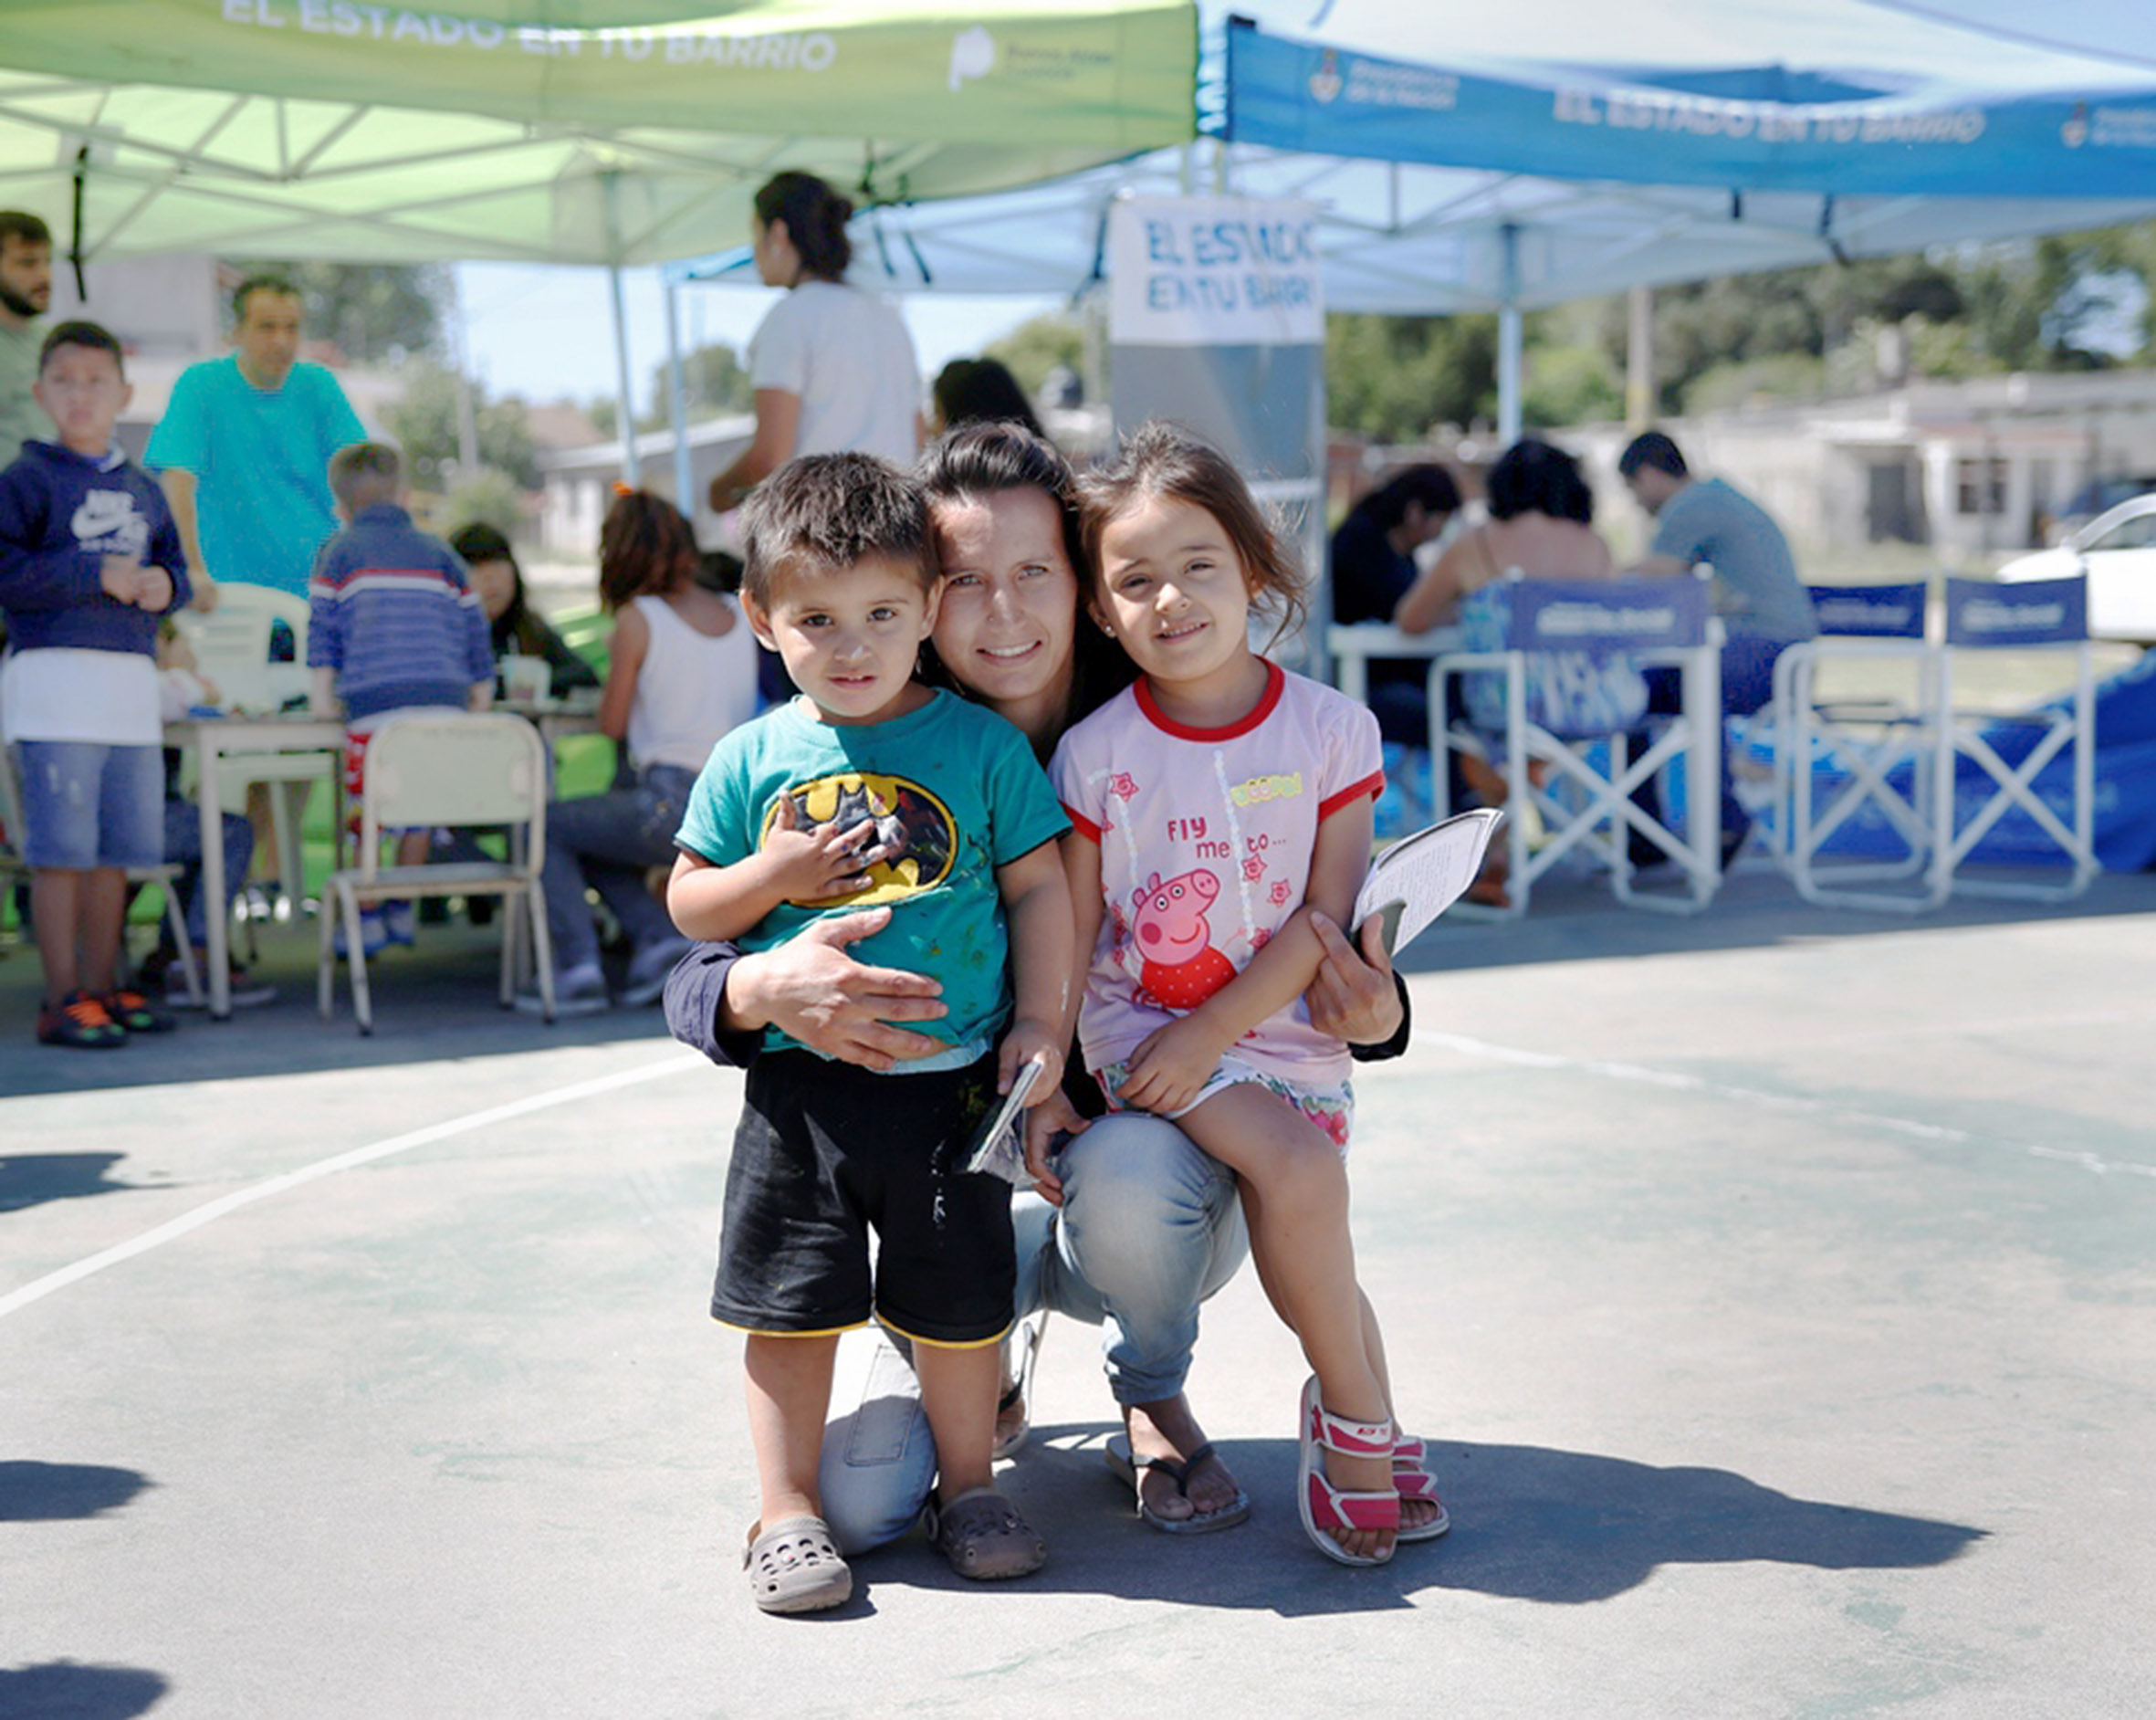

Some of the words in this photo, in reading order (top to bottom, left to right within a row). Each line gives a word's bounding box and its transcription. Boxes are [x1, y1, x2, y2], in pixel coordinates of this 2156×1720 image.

[221, 0, 286, 28] EL
[299, 0, 506, 49] ESTADO
[518, 23, 582, 56] EN
[598, 26, 654, 62] TU
[665, 27, 837, 72] BARRIO
[1553, 89, 1601, 126] EL
[1606, 91, 1756, 138] ESTADO
[1196, 840, 1230, 859] me
